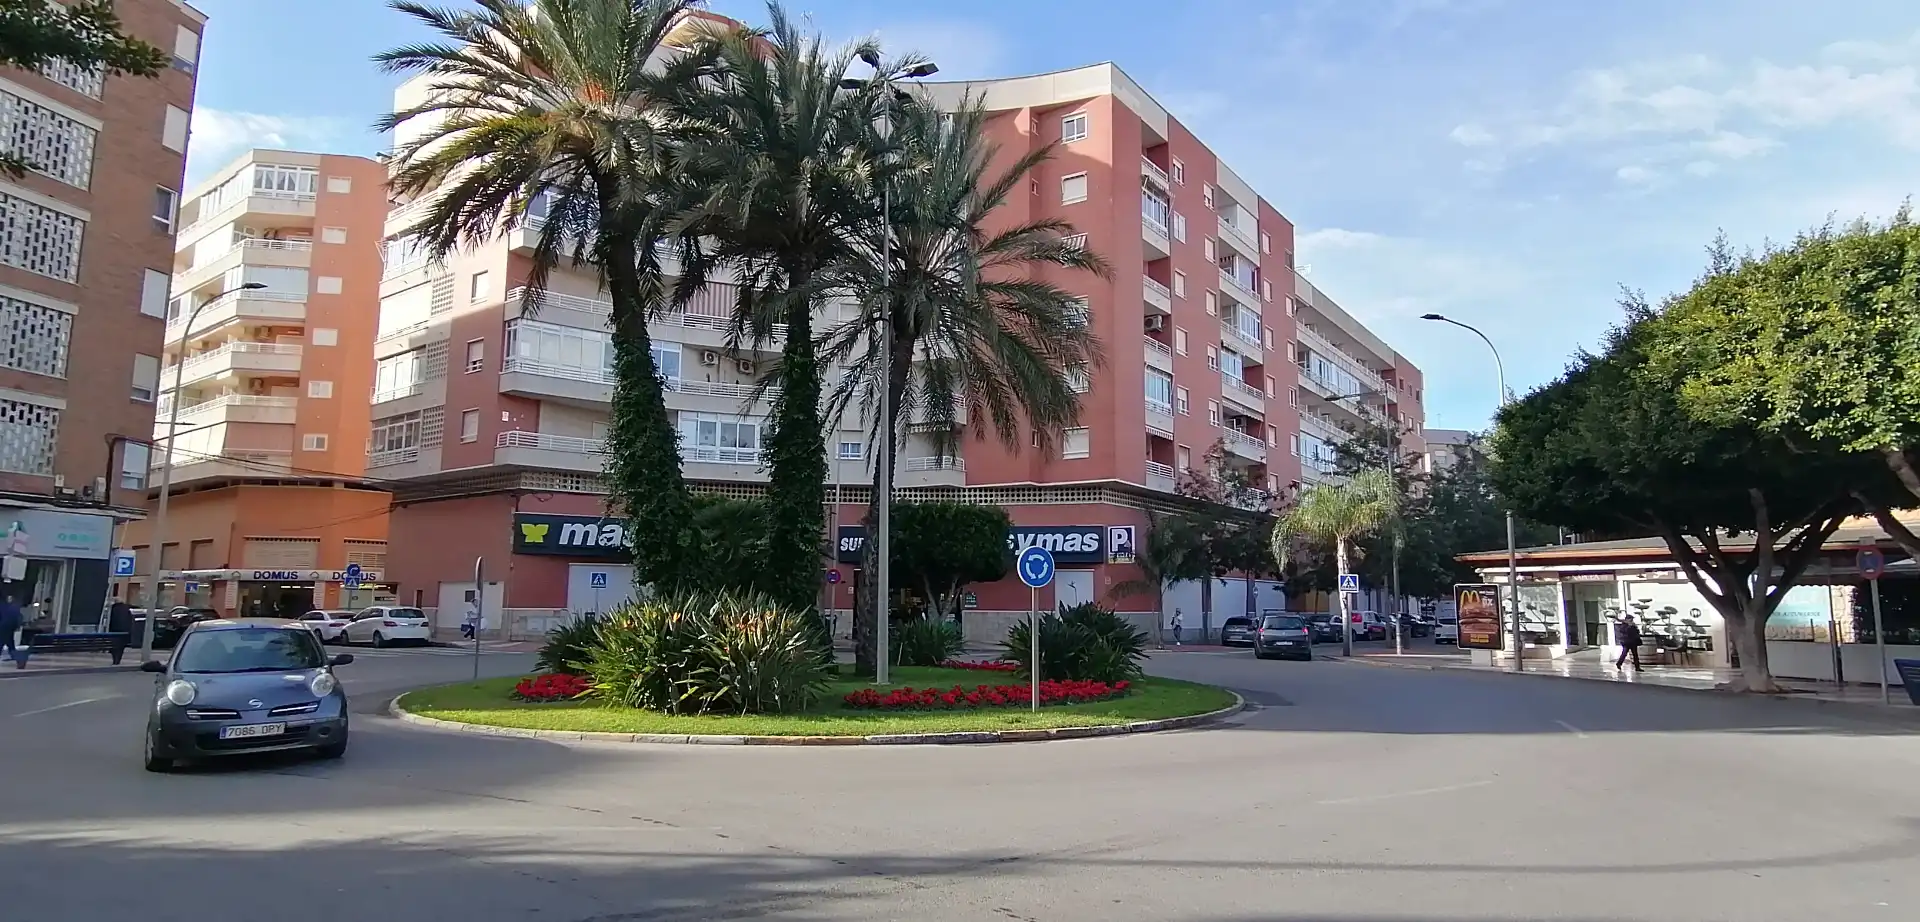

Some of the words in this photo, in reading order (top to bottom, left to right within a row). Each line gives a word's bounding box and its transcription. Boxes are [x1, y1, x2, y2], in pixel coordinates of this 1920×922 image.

[1111, 528, 1129, 552] P
[117, 558, 130, 573] P
[253, 571, 299, 579] DOMUS
[331, 572, 376, 581] DOUS
